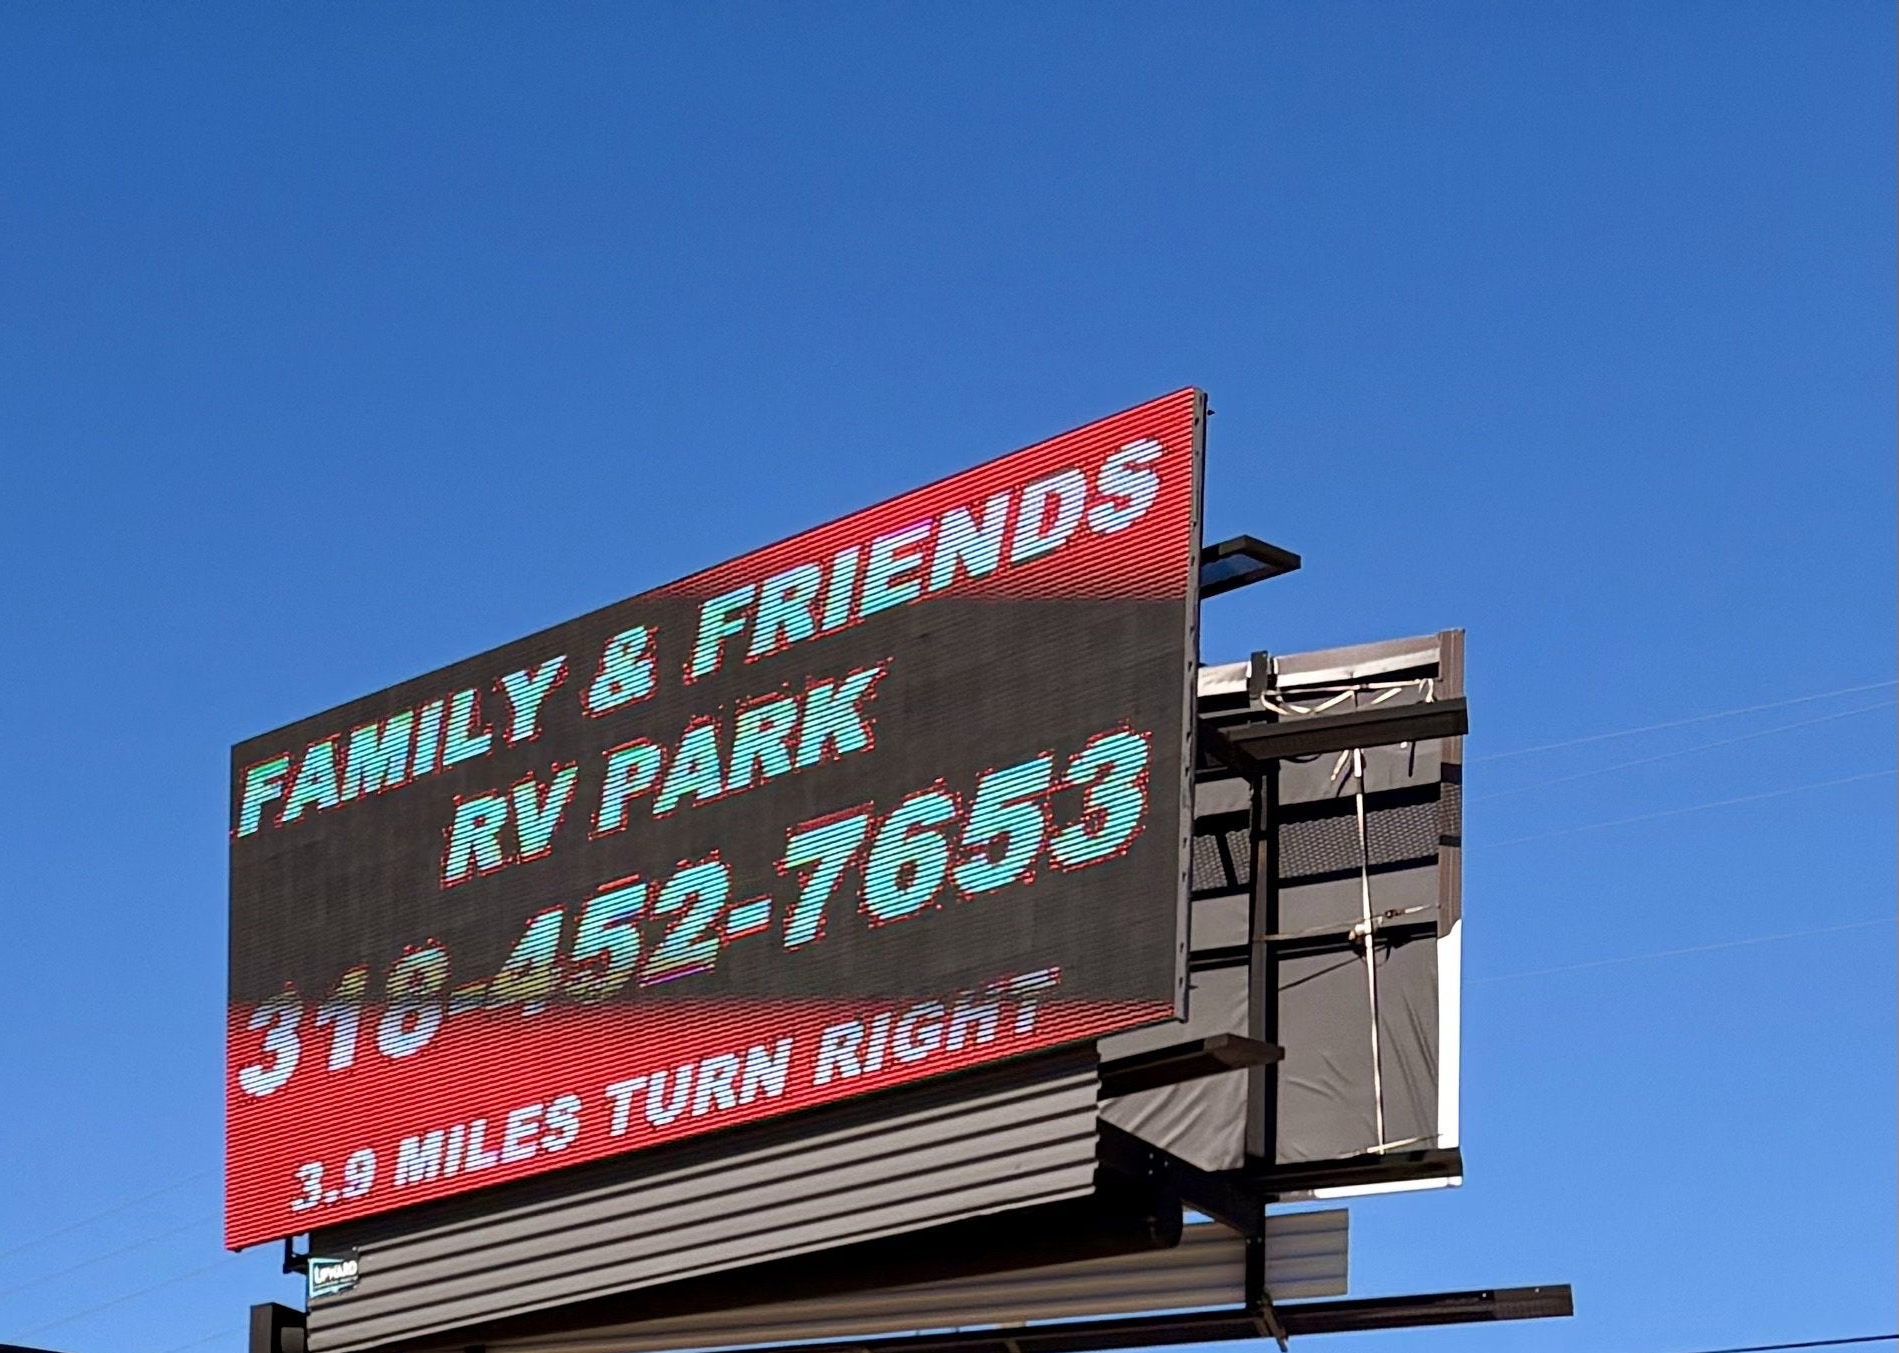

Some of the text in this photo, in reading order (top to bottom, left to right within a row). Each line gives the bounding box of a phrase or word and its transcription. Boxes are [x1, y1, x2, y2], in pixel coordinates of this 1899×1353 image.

[237, 437, 1163, 838] FAMILY & FRIENDS
[444, 666, 880, 881] RV PARK
[238, 730, 1150, 1098] 318-452-7653
[291, 967, 1061, 1212] 3.9 MILES TURN RIGHT
